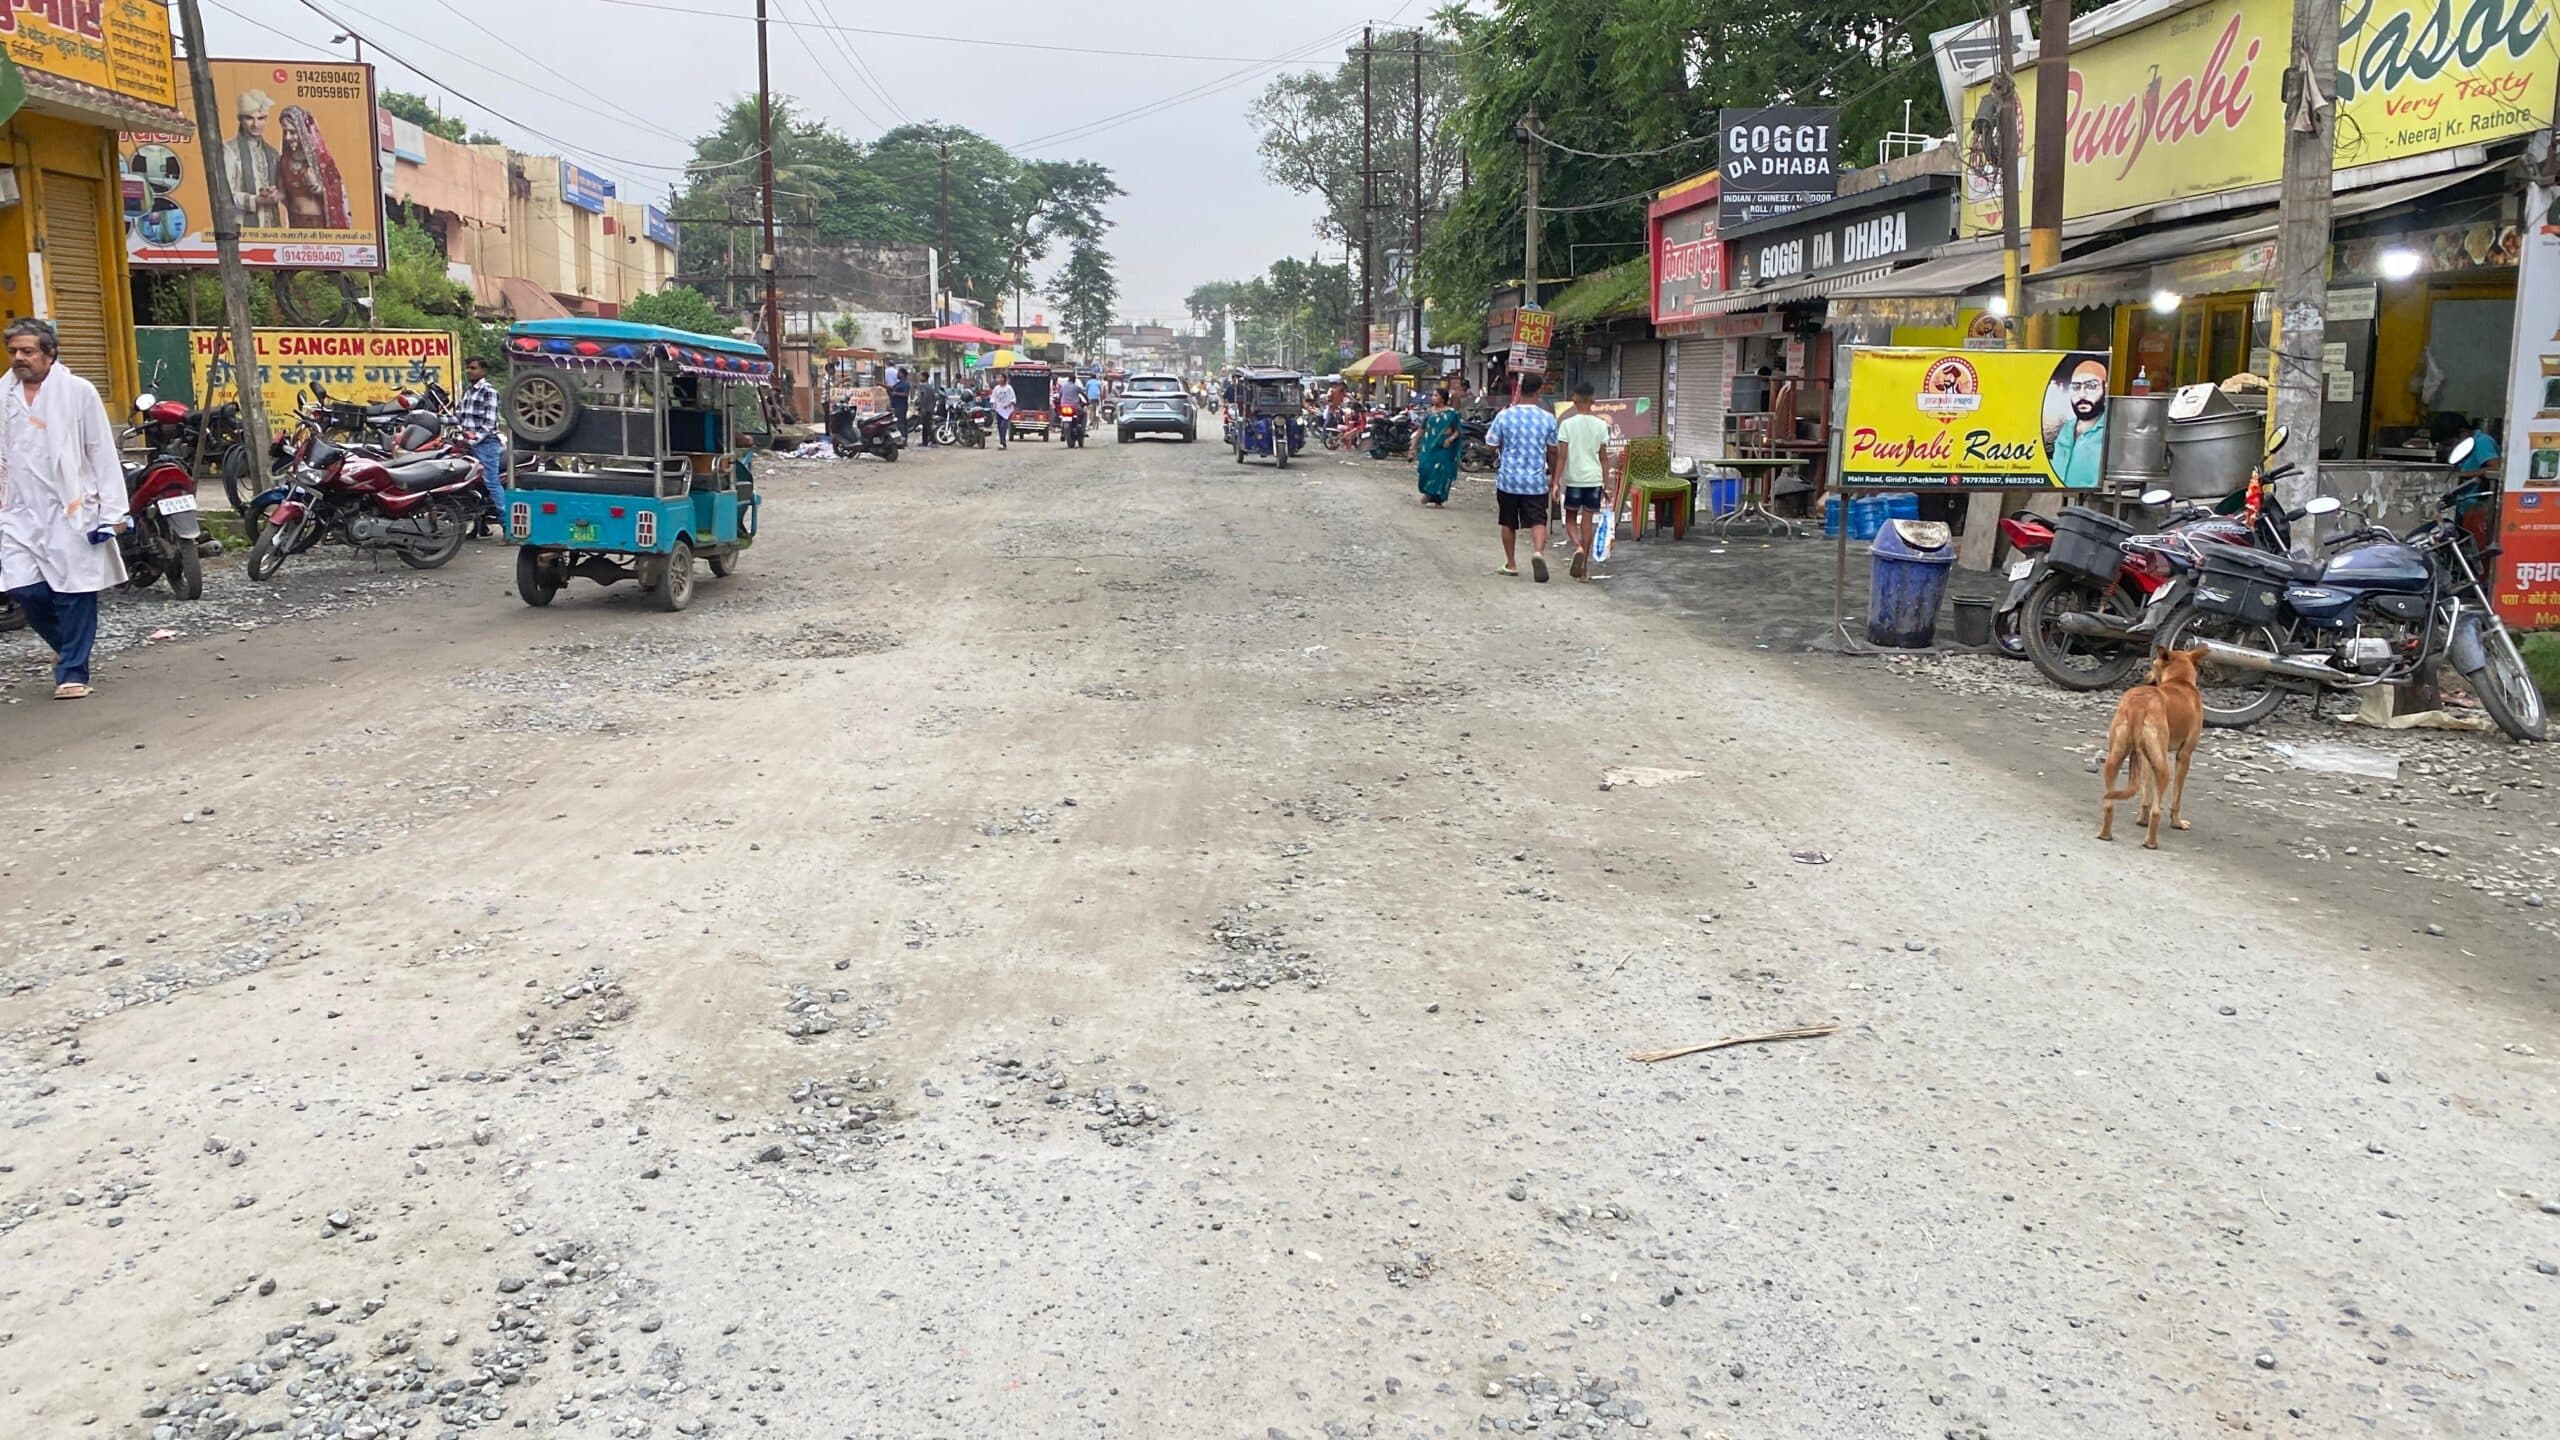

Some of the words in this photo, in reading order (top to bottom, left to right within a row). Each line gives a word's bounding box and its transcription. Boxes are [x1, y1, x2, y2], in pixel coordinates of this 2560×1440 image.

[296, 70, 360, 84] 9142690402
[297, 86, 360, 99] 8709598617
[2386, 93, 2444, 120] Very
[2455, 71, 2534, 102] Tasty
[2397, 127, 2441, 147] Neeraj
[2445, 119, 2466, 137] Kr.
[2470, 107, 2531, 132] Rathore
[1729, 125, 1829, 153] GOGGI
[1727, 156, 1757, 179] DA
[1761, 157, 1830, 175] DHABA
[1723, 194, 1752, 203] INDIAN
[1757, 194, 1790, 203] CHINESE
[1749, 205, 1769, 214] ROLL
[285, 250, 342, 262] 9142690402
[1760, 239, 1804, 279] GOGGI
[1812, 231, 1834, 270] DA
[1843, 211, 1907, 264] DHABA
[278, 336, 365, 356] SANGAM
[370, 337, 449, 357] GARDEN
[278, 359, 355, 385] संगम
[1851, 428, 1954, 468] Punjabi
[1963, 429, 2037, 462] Rasoi
[1847, 475, 1864, 483] Main
[1885, 475, 1907, 484] Giridih
